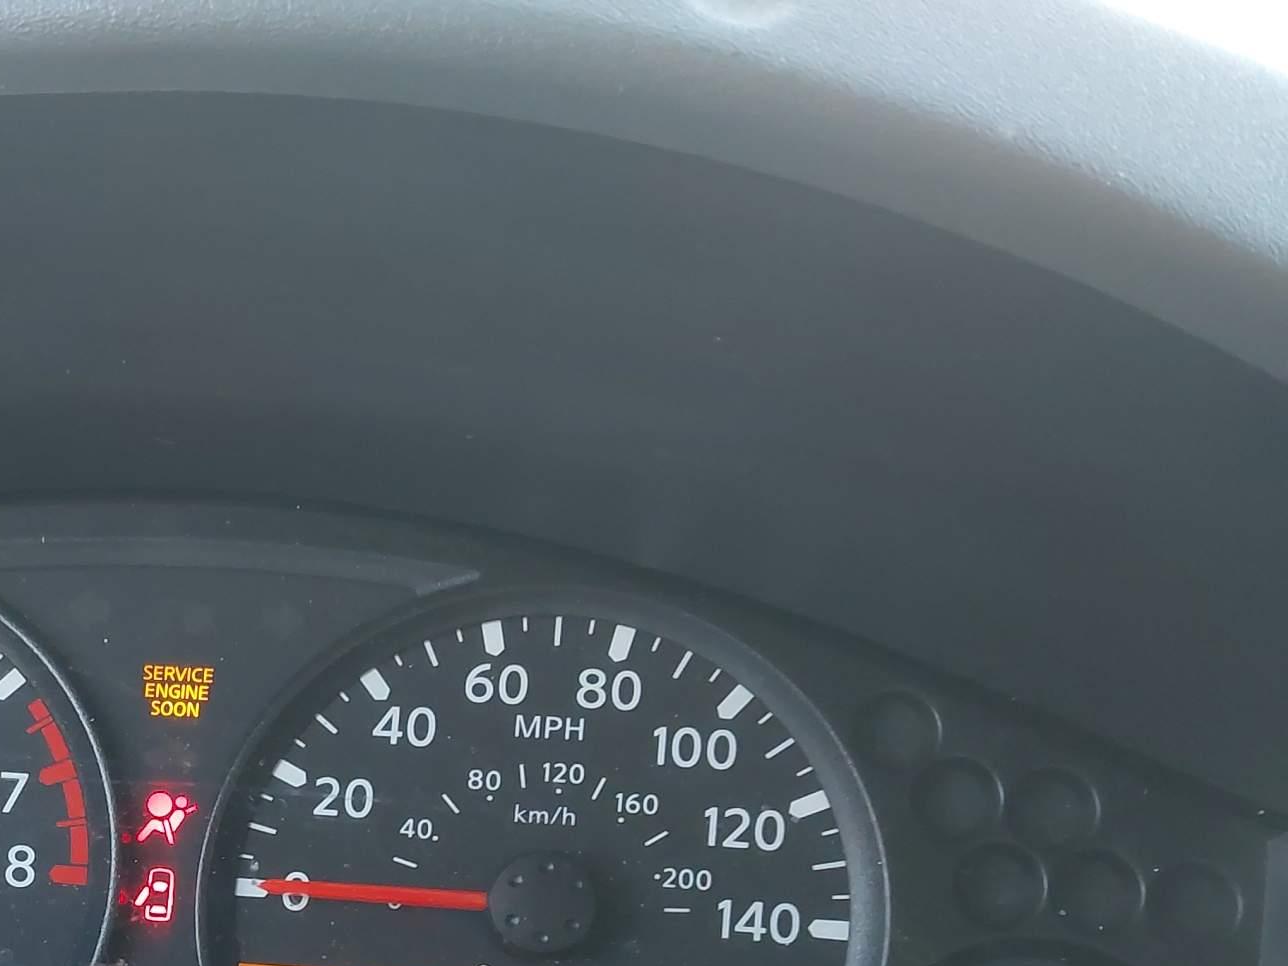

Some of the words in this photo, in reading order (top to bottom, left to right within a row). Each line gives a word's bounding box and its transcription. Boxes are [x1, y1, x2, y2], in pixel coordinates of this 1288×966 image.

[143, 665, 214, 683] SERVICE
[464, 664, 529, 704] 60
[144, 683, 210, 701] ENGINE
[575, 668, 642, 711] 80
[150, 701, 200, 718] SOON
[372, 706, 437, 747] 40
[513, 714, 585, 741] MPH
[652, 726, 737, 770] 100
[467, 769, 501, 791] 80
[541, 763, 584, 785] 120
[0, 771, 29, 813] 7
[313, 777, 374, 818] 20
[615, 793, 659, 815] 160
[513, 804, 577, 826] km/h
[399, 818, 433, 840] 40
[703, 807, 785, 851] 120
[5, 844, 35, 888] 8
[661, 867, 712, 891] 200
[716, 900, 800, 945] 140
